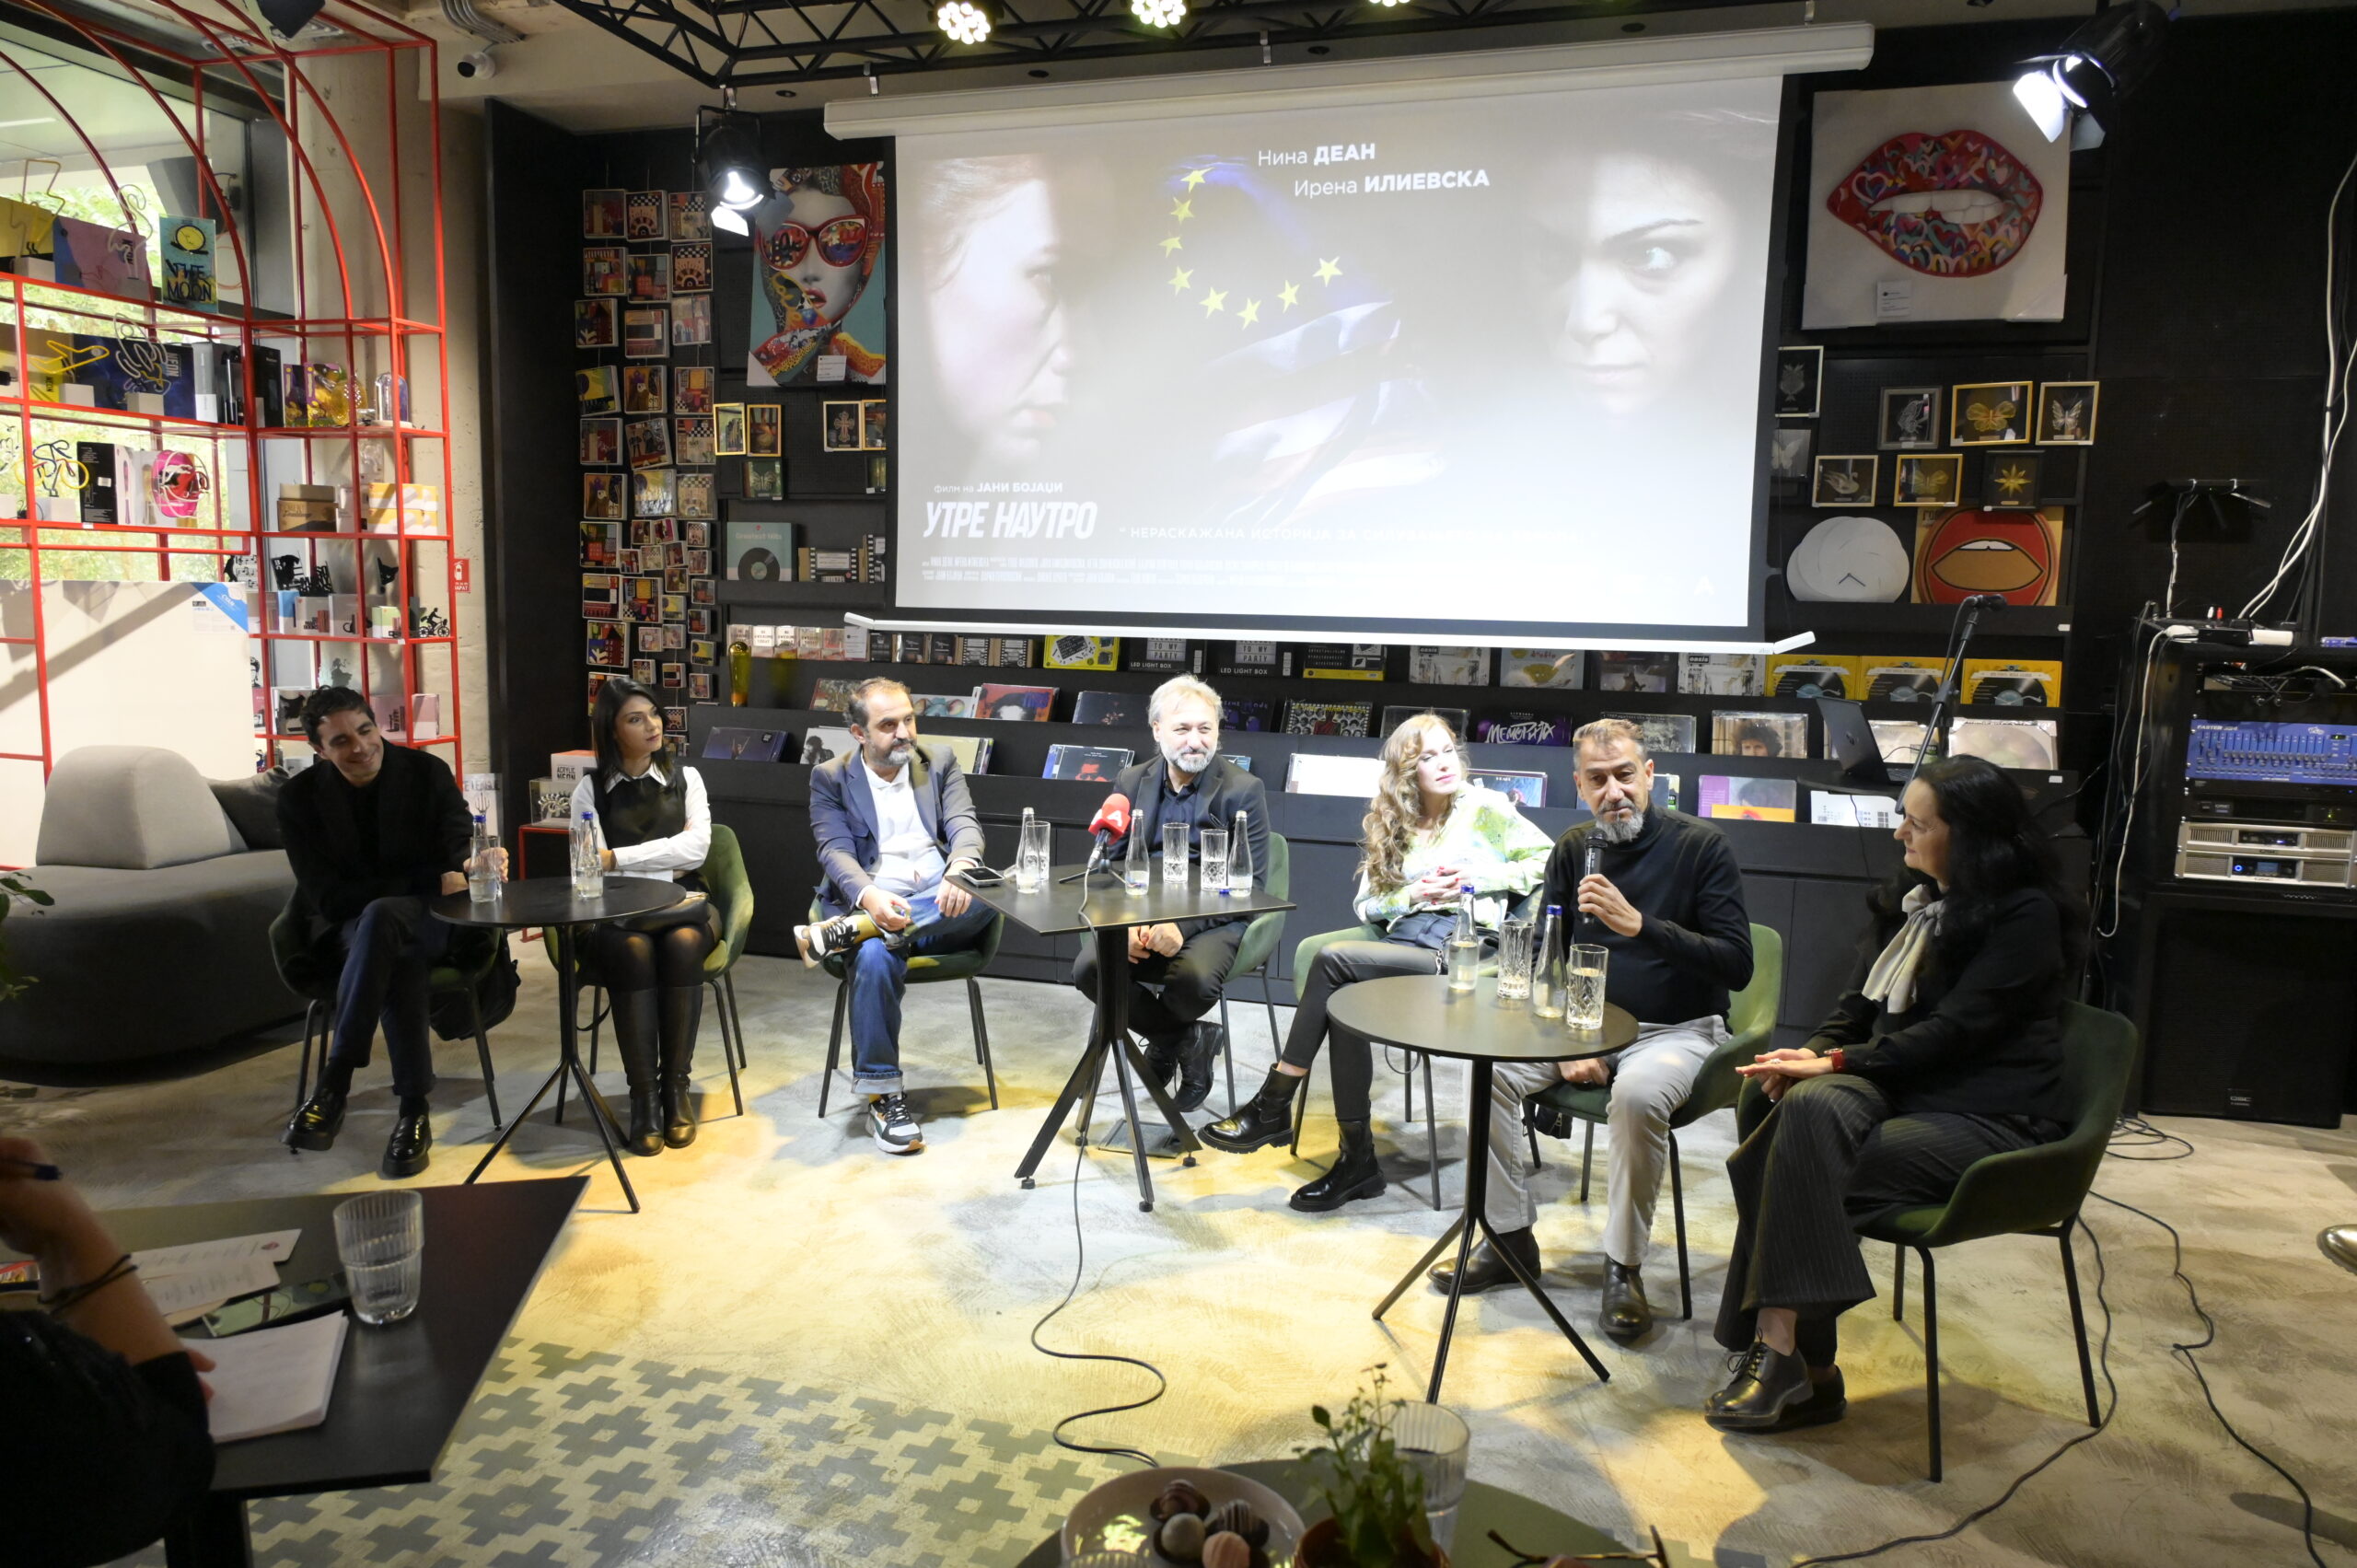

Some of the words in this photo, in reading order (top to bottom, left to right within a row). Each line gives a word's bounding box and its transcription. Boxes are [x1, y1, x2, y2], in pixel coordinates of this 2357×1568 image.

[1258, 148, 1307, 167] Нина
[1313, 143, 1376, 166] ДЕАН
[1294, 178, 1358, 199] Ирена
[1364, 168, 1490, 192] ИЛИЕВСКА
[167, 278, 212, 301] MOON
[923, 501, 989, 539] УТРЕ
[993, 501, 1098, 540] НАУТРО
[1130, 527, 1245, 540] НЕРАСКАЖАНА
[1251, 528, 1332, 541] ИСТОРИЈА
[1154, 651, 1178, 660] PARTY
[1243, 655, 1268, 663] PARTY
[1689, 656, 1709, 664] oasis
